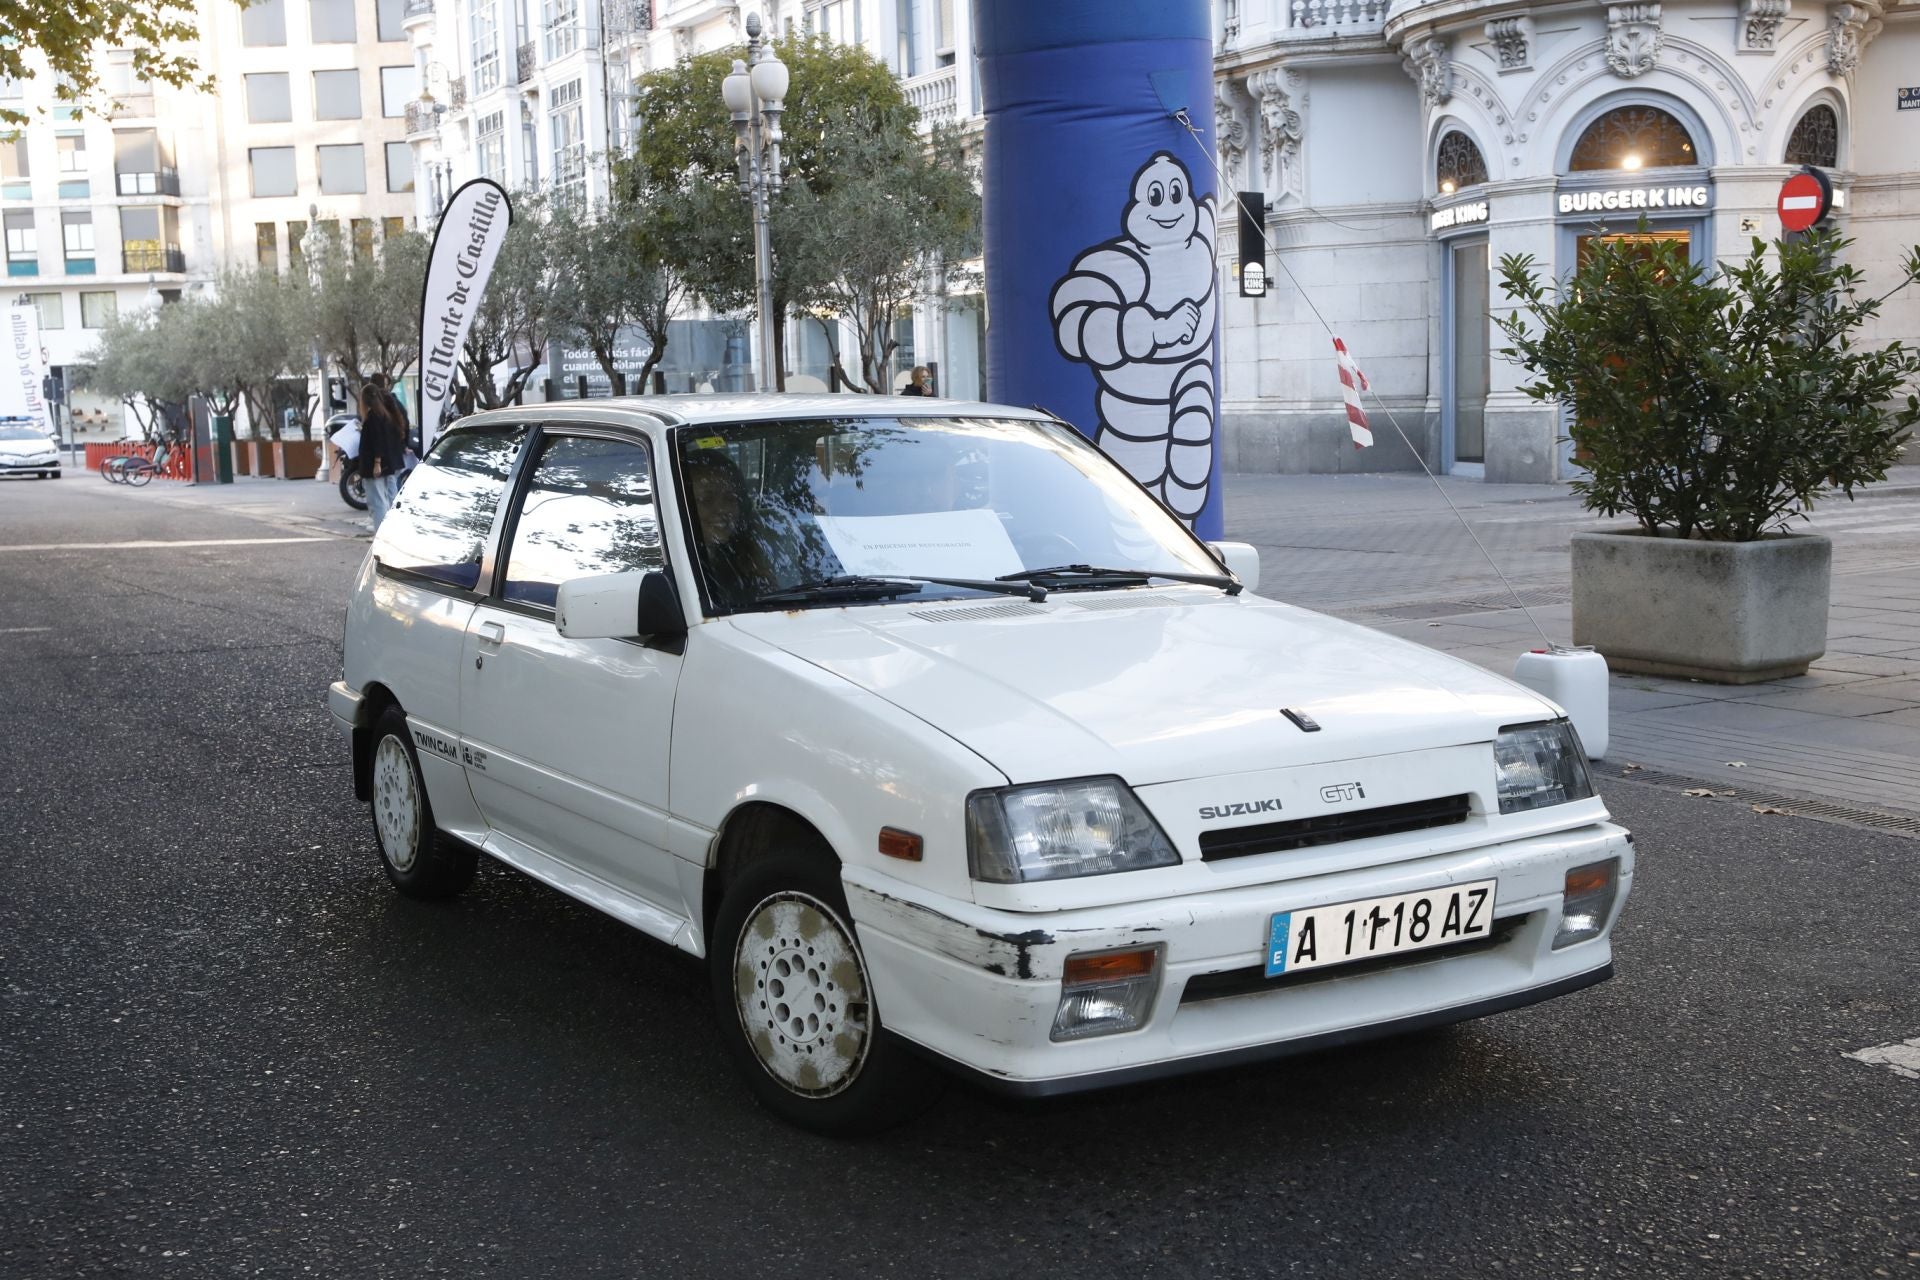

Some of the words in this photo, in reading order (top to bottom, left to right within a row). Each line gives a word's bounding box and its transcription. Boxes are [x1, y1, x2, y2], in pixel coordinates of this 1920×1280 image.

[1559, 189, 1647, 212] BURGER
[1649, 187, 1707, 207] KING
[1455, 202, 1487, 224] KING
[456, 190, 501, 280] Castilla
[446, 280, 471, 306] de
[1244, 279, 1264, 289] KING
[429, 307, 464, 369] Norte
[562, 349, 589, 359] Todo
[630, 346, 653, 357] fácil
[562, 360, 603, 371] cuando
[425, 371, 449, 402] El
[563, 373, 575, 384] el
[415, 730, 437, 751] TWIN
[437, 739, 457, 760] CAM
[1199, 798, 1283, 820] SUZUKI
[1319, 781, 1366, 804] GTi
[1273, 950, 1283, 965] E
[1294, 916, 1317, 964] A
[1344, 897, 1433, 956] 1118
[1440, 887, 1489, 938] AZ
